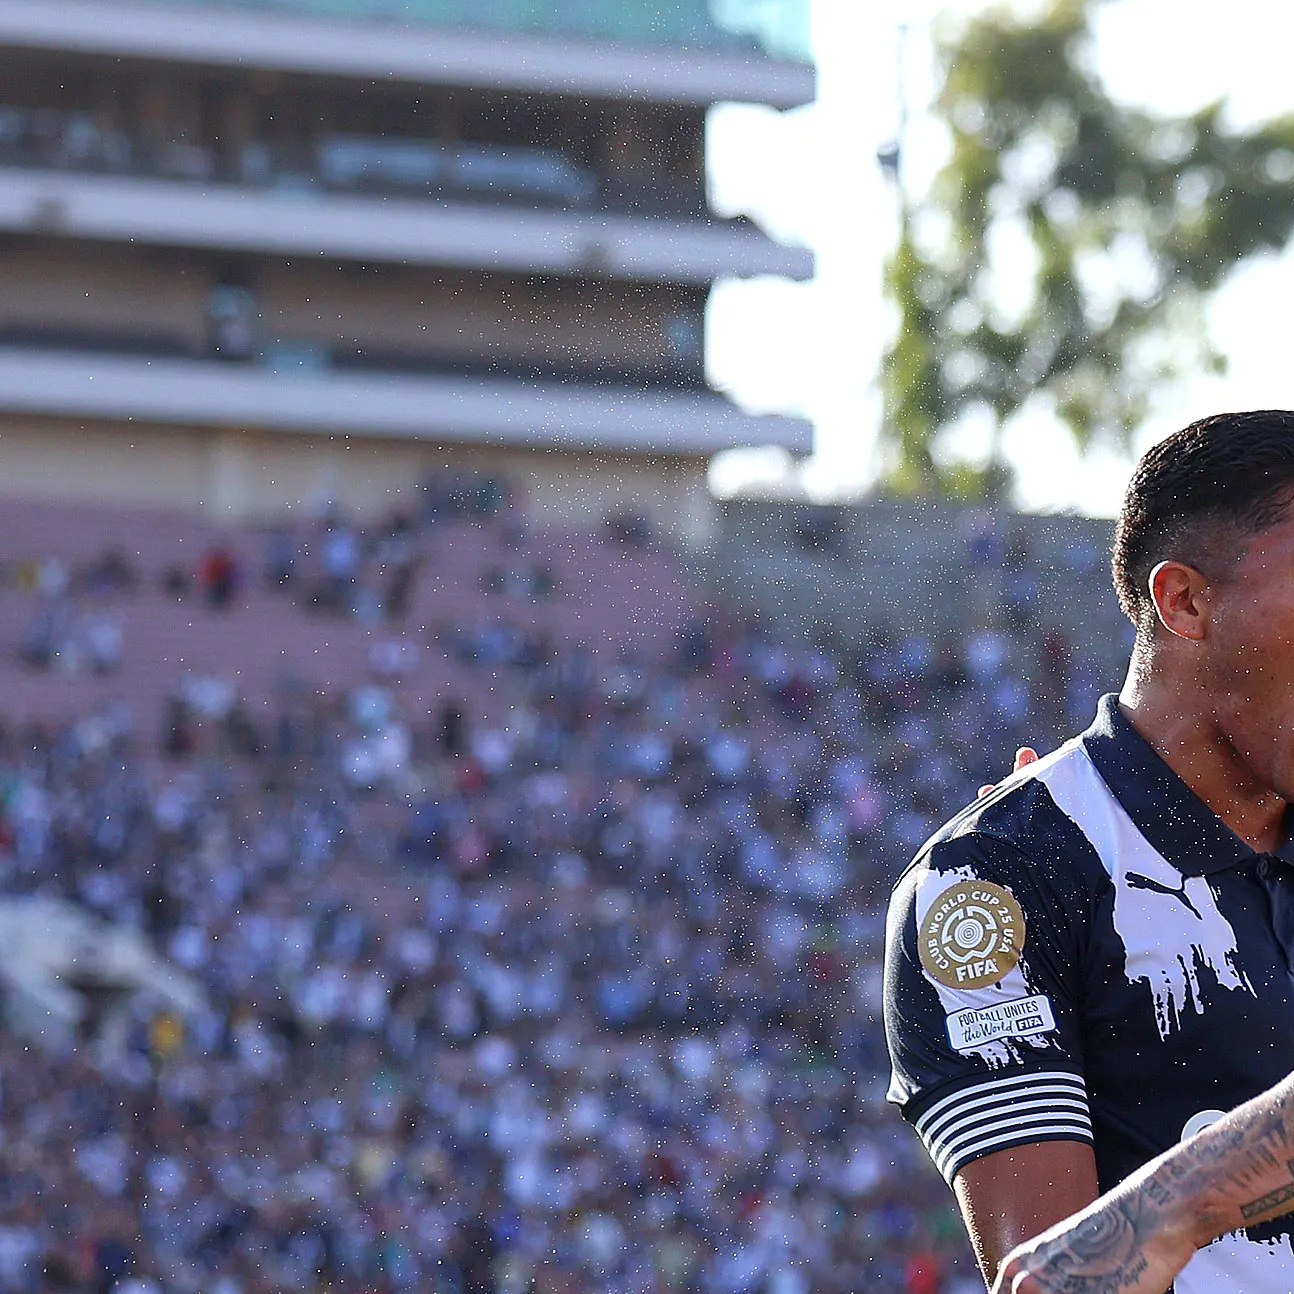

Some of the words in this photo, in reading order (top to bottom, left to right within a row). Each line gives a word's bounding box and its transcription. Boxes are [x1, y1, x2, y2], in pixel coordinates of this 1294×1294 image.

[971, 890, 1000, 906] CUP
[928, 892, 967, 934] WORLD
[997, 907, 1014, 924] 25
[928, 938, 949, 970] CLUB
[997, 928, 1014, 954] USA
[956, 958, 999, 982] FIFA
[958, 1008, 1002, 1027] FOOTBALL
[1005, 1000, 1039, 1019] UNITES
[962, 1027, 981, 1043] the
[980, 1020, 1014, 1041] World
[1017, 1016, 1043, 1031] FIFA
